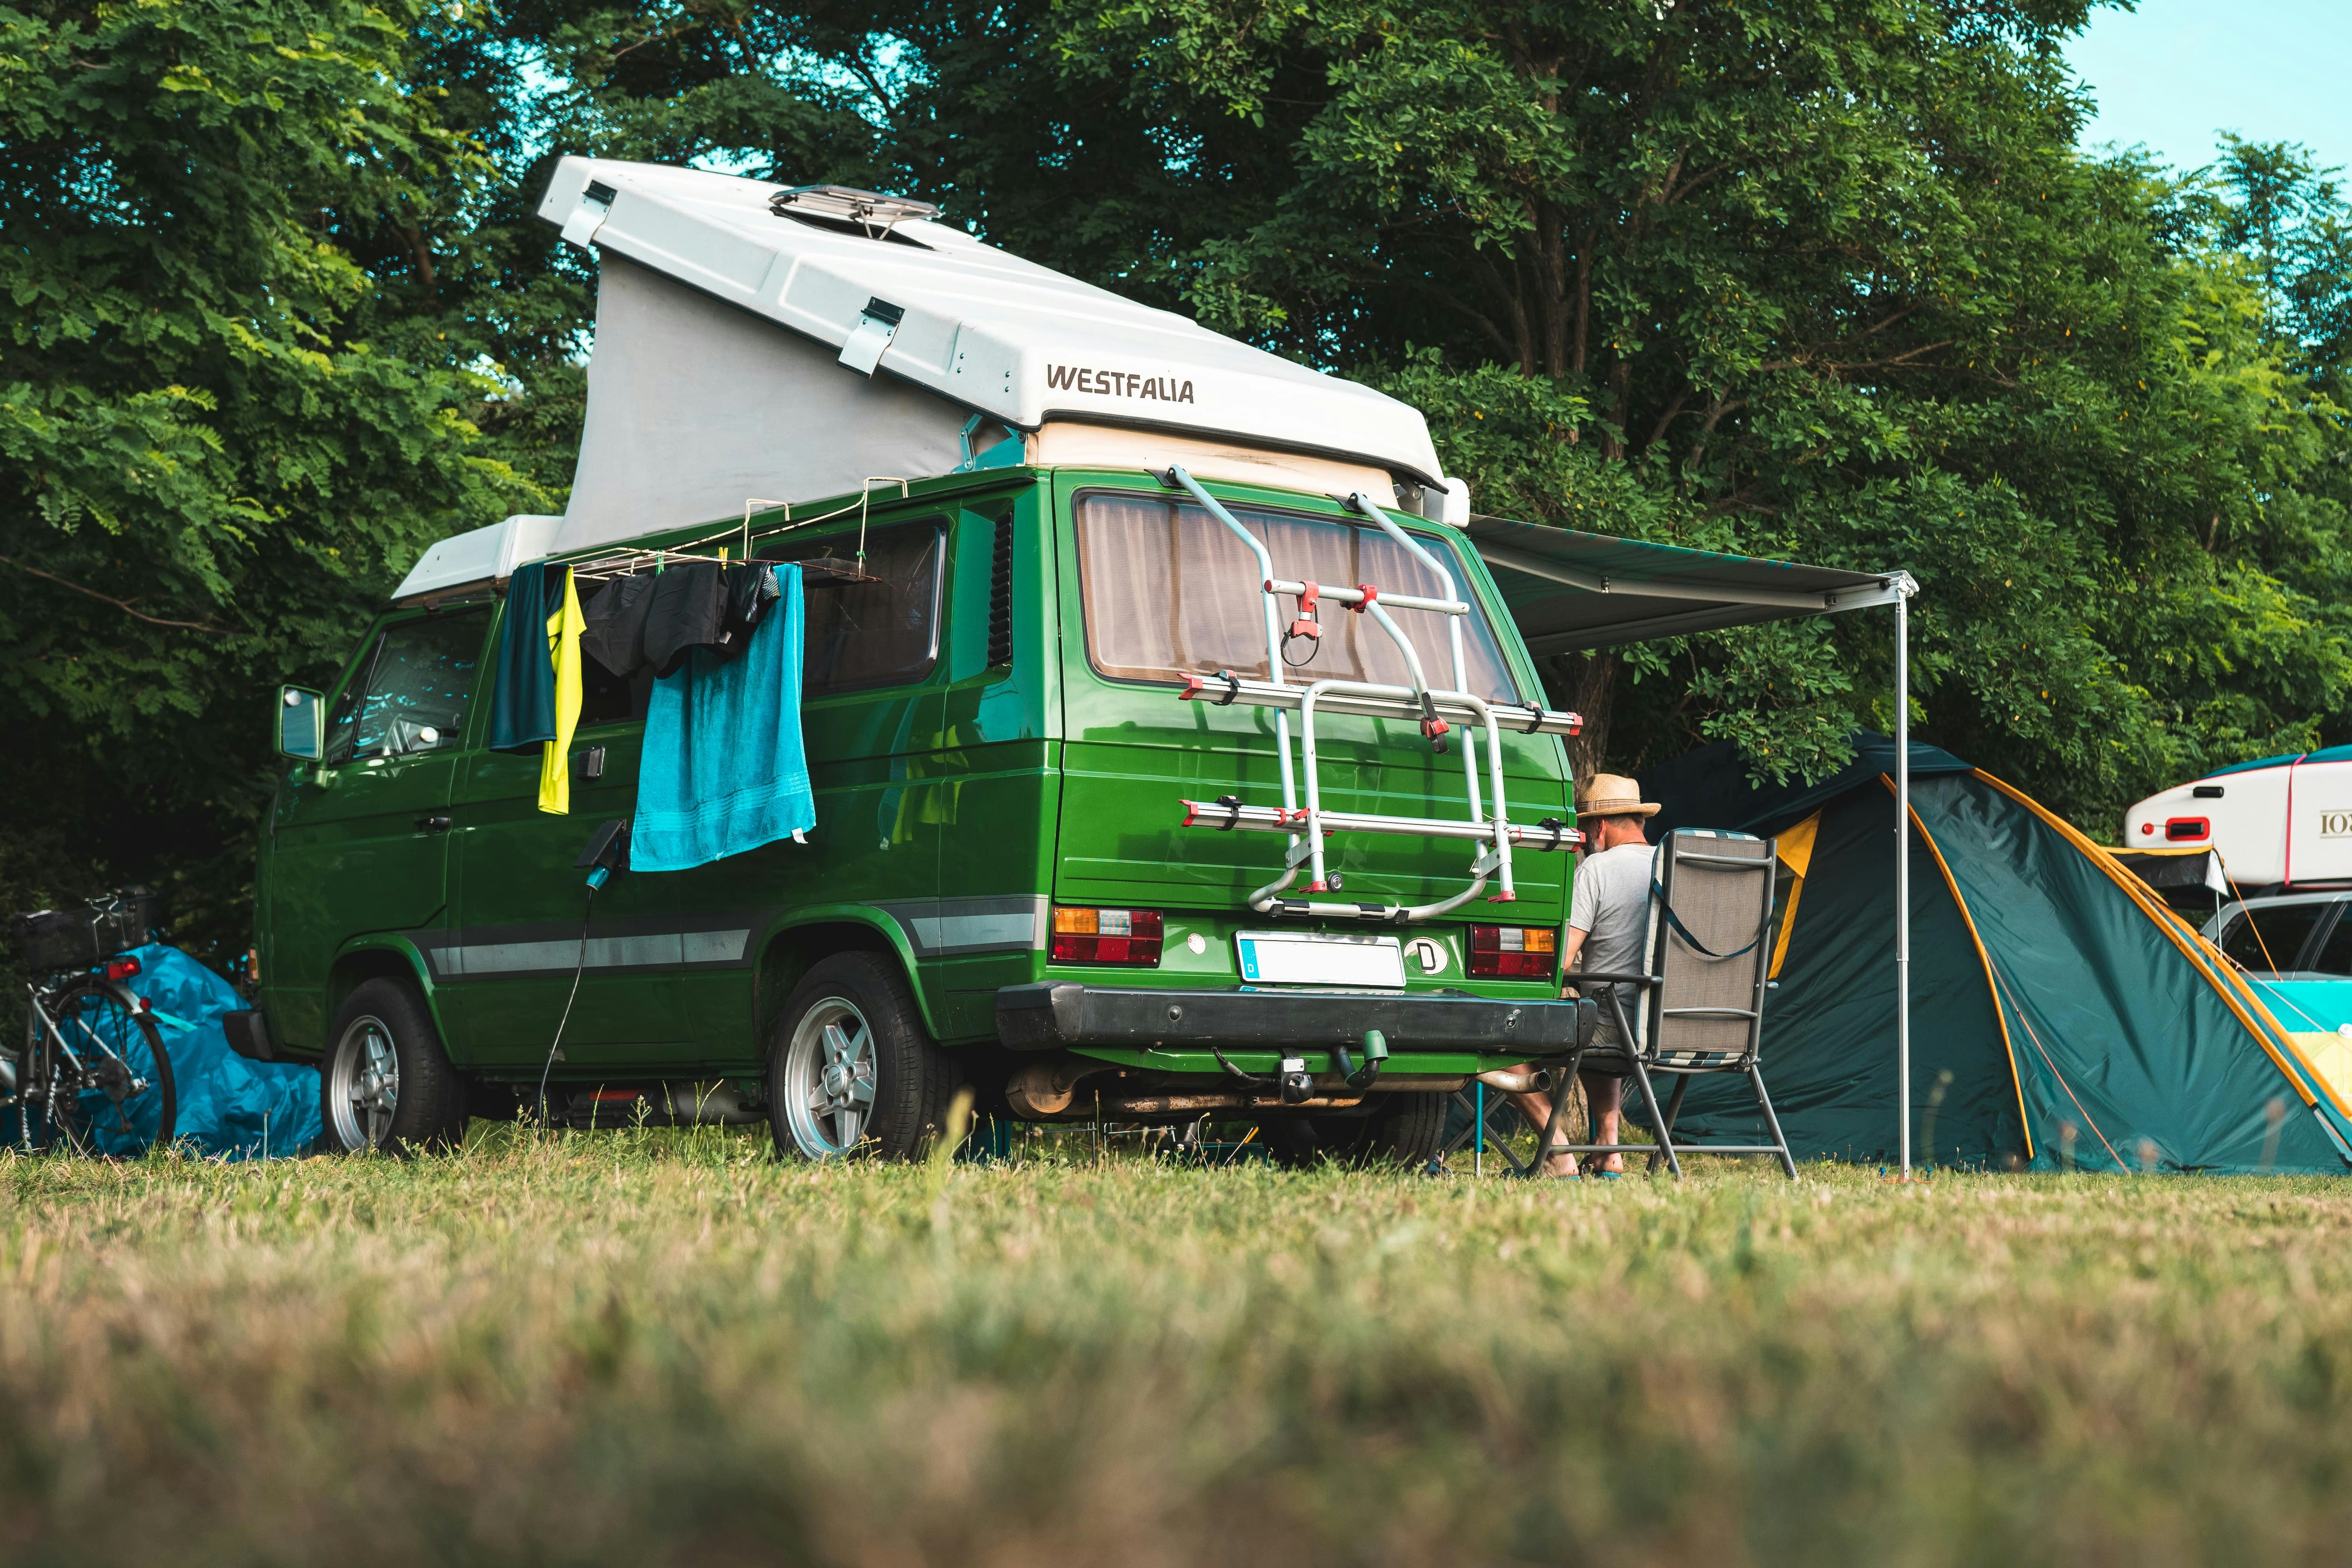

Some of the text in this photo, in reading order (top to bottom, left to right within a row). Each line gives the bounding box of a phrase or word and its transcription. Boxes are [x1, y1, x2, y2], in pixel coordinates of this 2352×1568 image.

[1047, 364, 1194, 404] WESTFALIA
[1247, 963, 1254, 973] D
[1417, 942, 1436, 970] D
